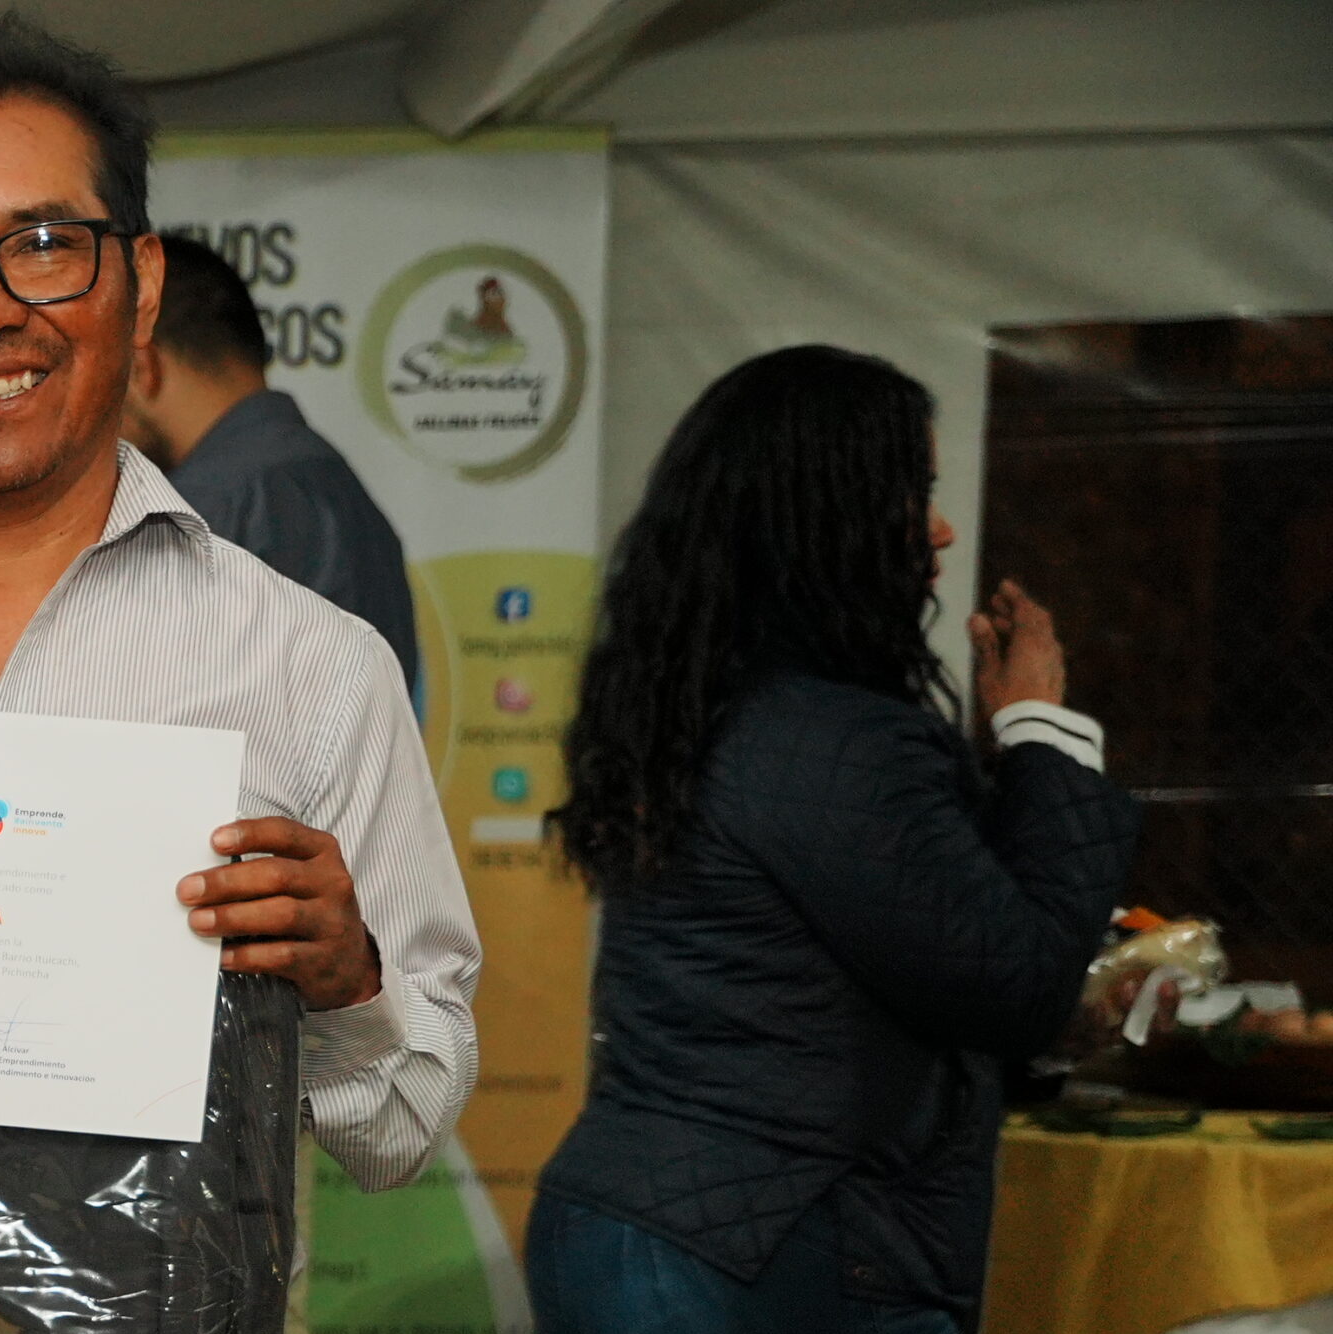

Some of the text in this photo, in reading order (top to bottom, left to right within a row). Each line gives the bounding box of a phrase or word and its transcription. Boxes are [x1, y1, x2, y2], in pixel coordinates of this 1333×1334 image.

[159, 222, 296, 288] VOS
[23, 886, 53, 895] como
[13, 936, 22, 947] la
[1, 952, 32, 963] Barrio
[1, 966, 50, 980] Pichincha
